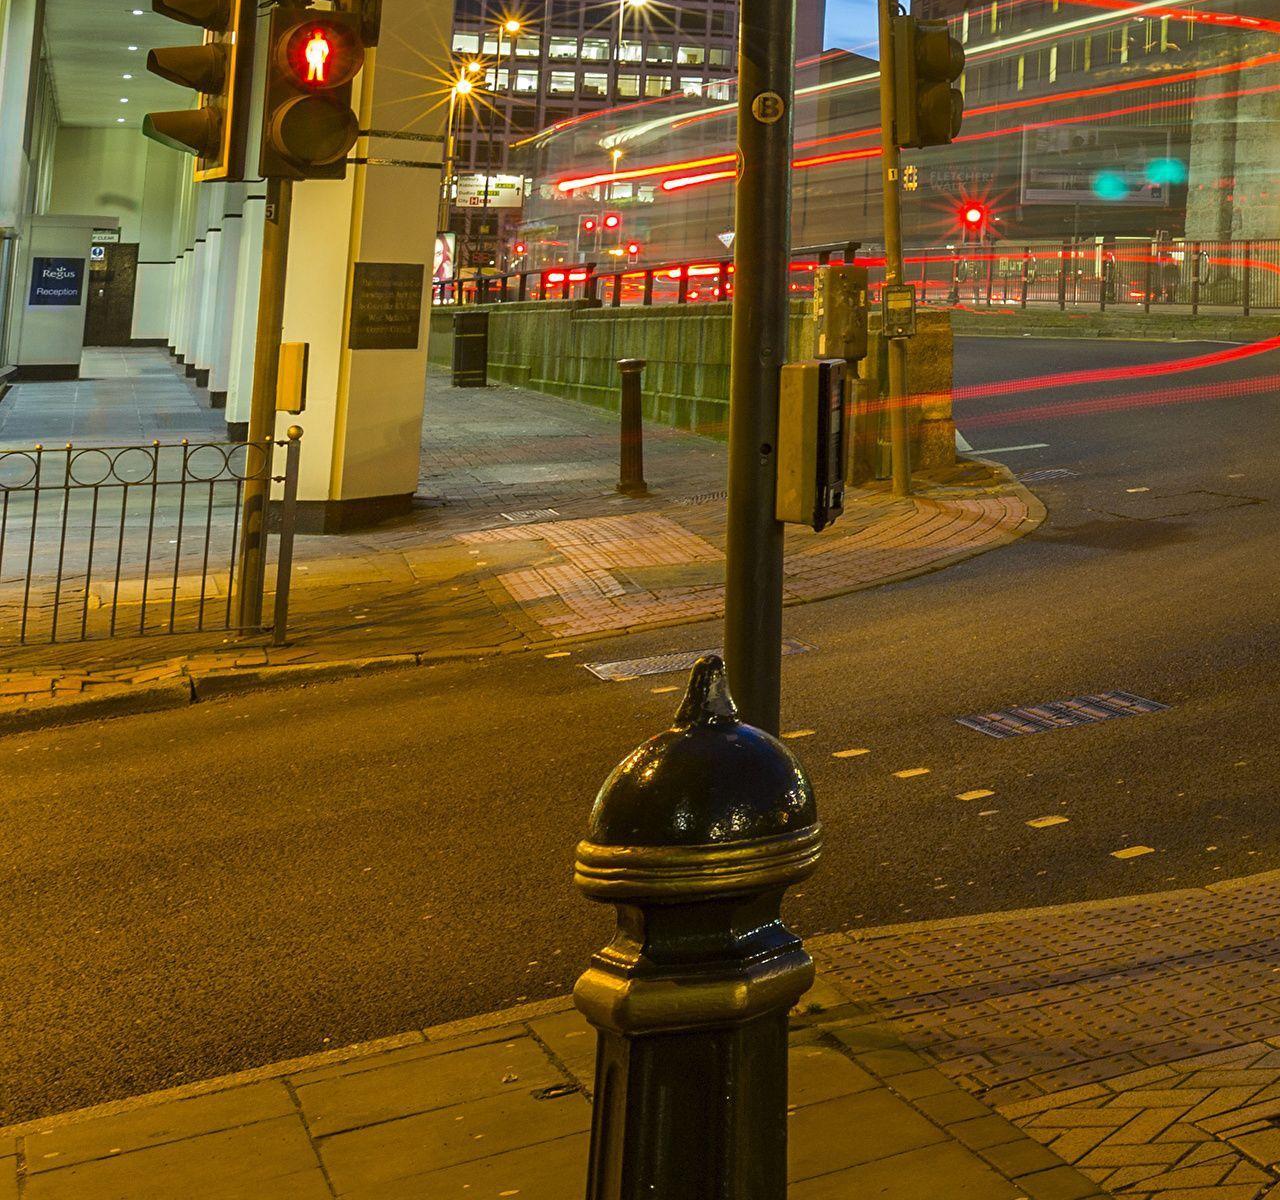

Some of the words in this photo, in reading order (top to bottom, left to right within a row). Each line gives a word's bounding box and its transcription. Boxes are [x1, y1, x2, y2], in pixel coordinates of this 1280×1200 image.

[761, 96, 779, 118] B
[43, 268, 76, 280] Regus
[36, 287, 78, 297] Reception
